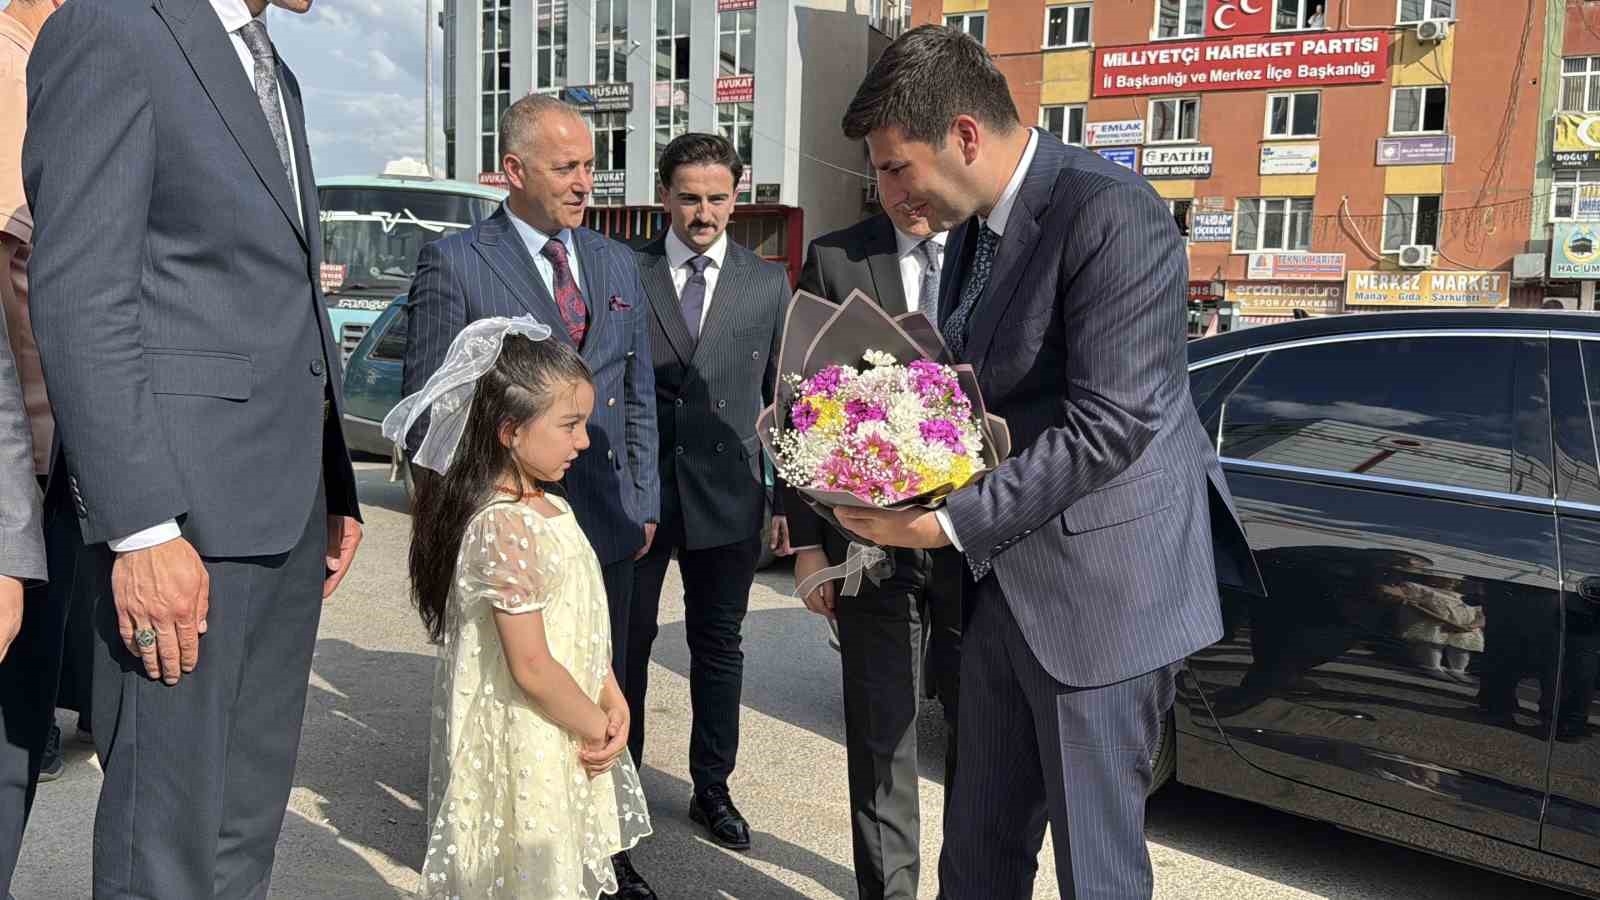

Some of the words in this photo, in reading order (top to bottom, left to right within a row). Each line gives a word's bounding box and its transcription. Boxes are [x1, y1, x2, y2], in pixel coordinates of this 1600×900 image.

[1206, 43, 1295, 61] HAREKET
[1116, 70, 1188, 89] Başkanlığı
[1191, 72, 1207, 83] ve
[1210, 67, 1261, 82] Merkez
[1266, 63, 1292, 82] İlçe
[1298, 61, 1375, 79] Başkanlığı
[718, 79, 752, 88] AVUKAT
[1102, 123, 1141, 132] EMLAK
[1160, 149, 1209, 162] FATİH
[1143, 166, 1169, 176] ERKEK
[594, 172, 624, 182] AVUKAT
[1356, 273, 1420, 290] MERKEZ
[1431, 273, 1500, 291] MARKET
